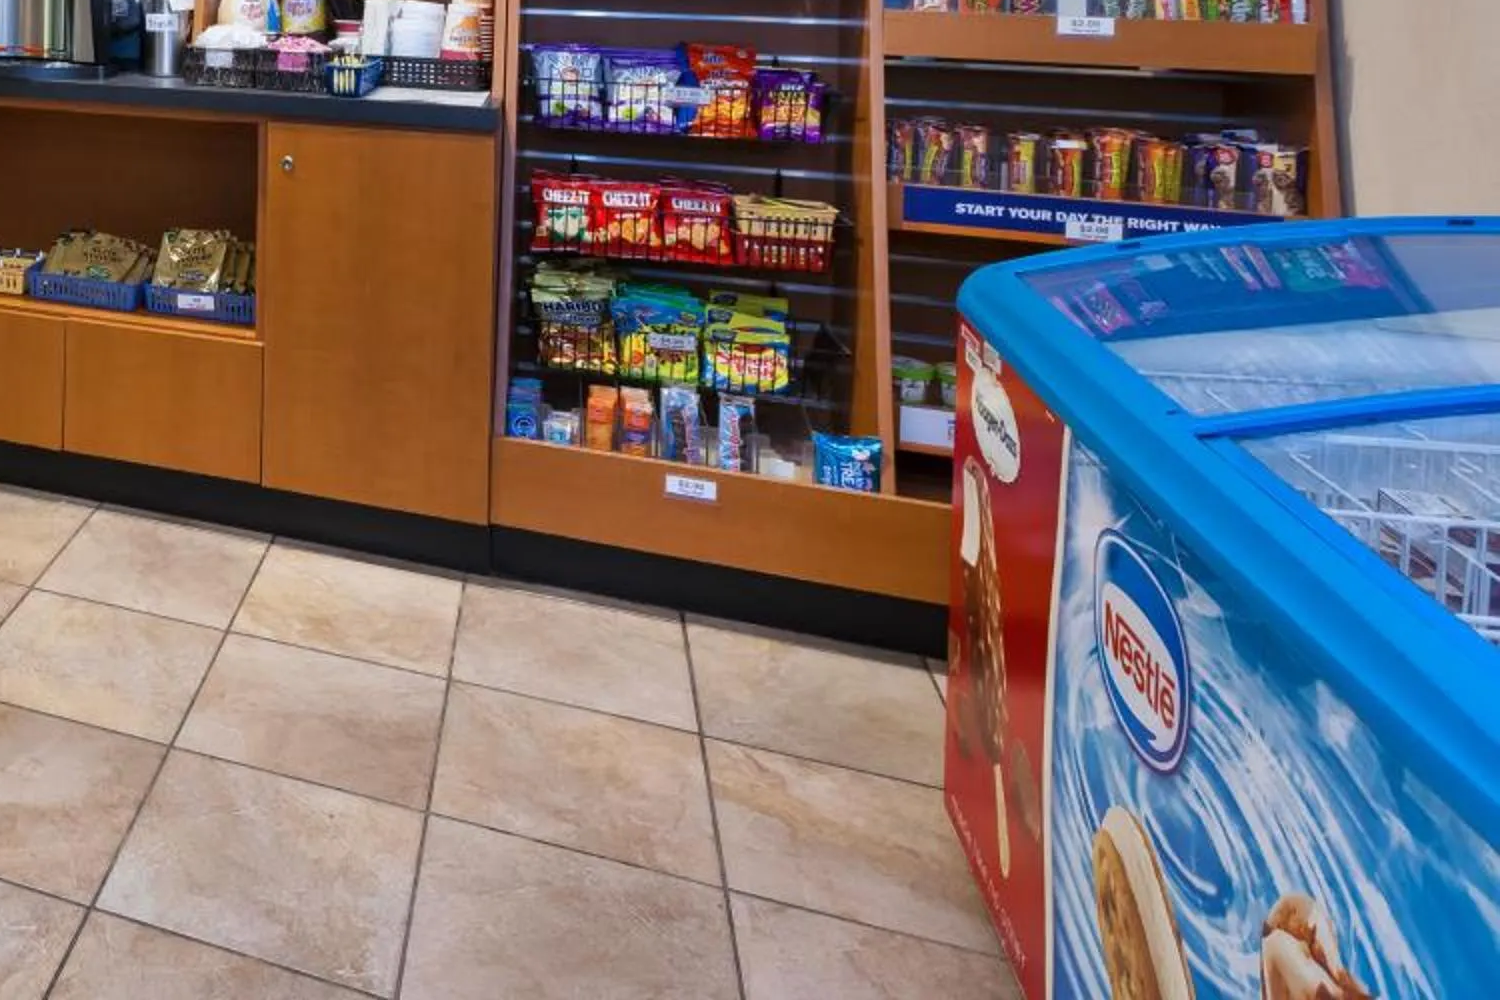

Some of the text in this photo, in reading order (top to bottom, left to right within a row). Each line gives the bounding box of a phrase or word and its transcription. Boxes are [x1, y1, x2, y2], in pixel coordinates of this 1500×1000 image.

[955, 203, 1005, 217] START
[1008, 207, 1052, 222] YOUR
[1056, 211, 1089, 225] DAY
[1091, 214, 1124, 225] THE
[1127, 217, 1181, 233] RIGHT
